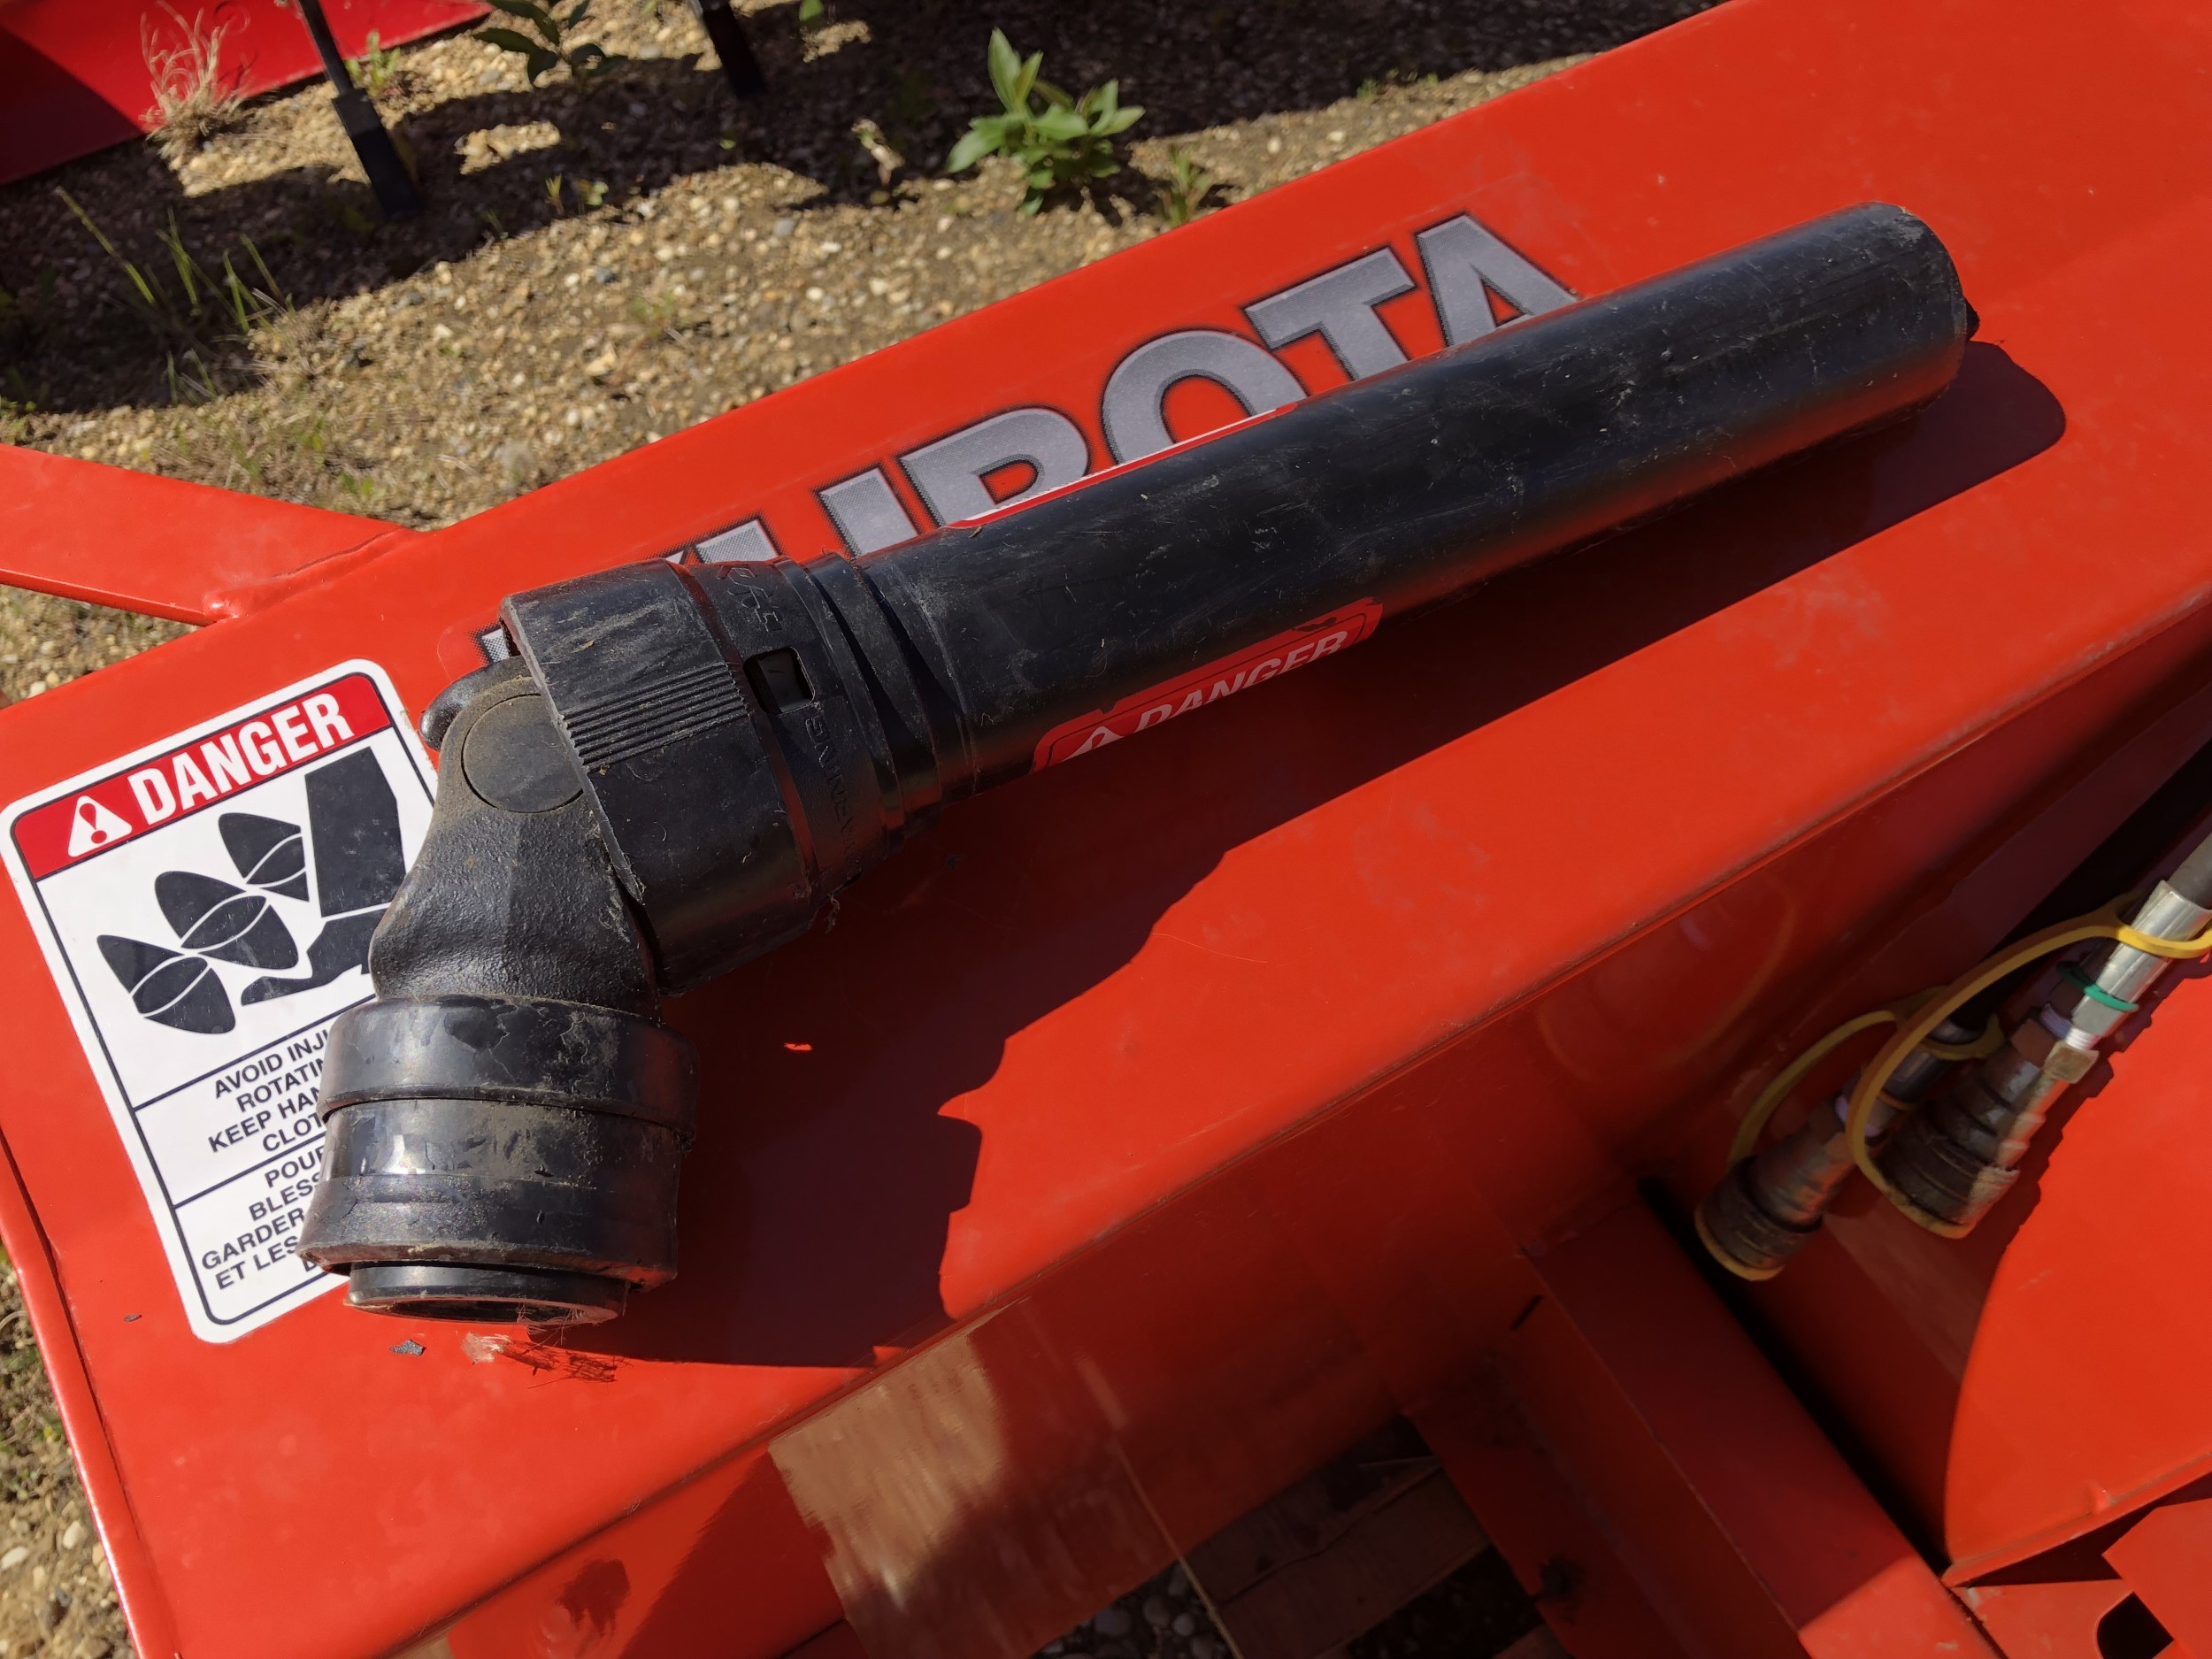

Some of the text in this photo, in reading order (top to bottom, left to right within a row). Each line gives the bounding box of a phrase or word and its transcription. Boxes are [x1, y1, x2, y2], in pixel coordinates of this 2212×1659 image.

[127, 693, 355, 826] DANGER
[214, 1053, 283, 1099] AVOID
[208, 1110, 272, 1153] KEEP
[202, 1207, 304, 1270] GARDER
[216, 1235, 298, 1290] ET LES
